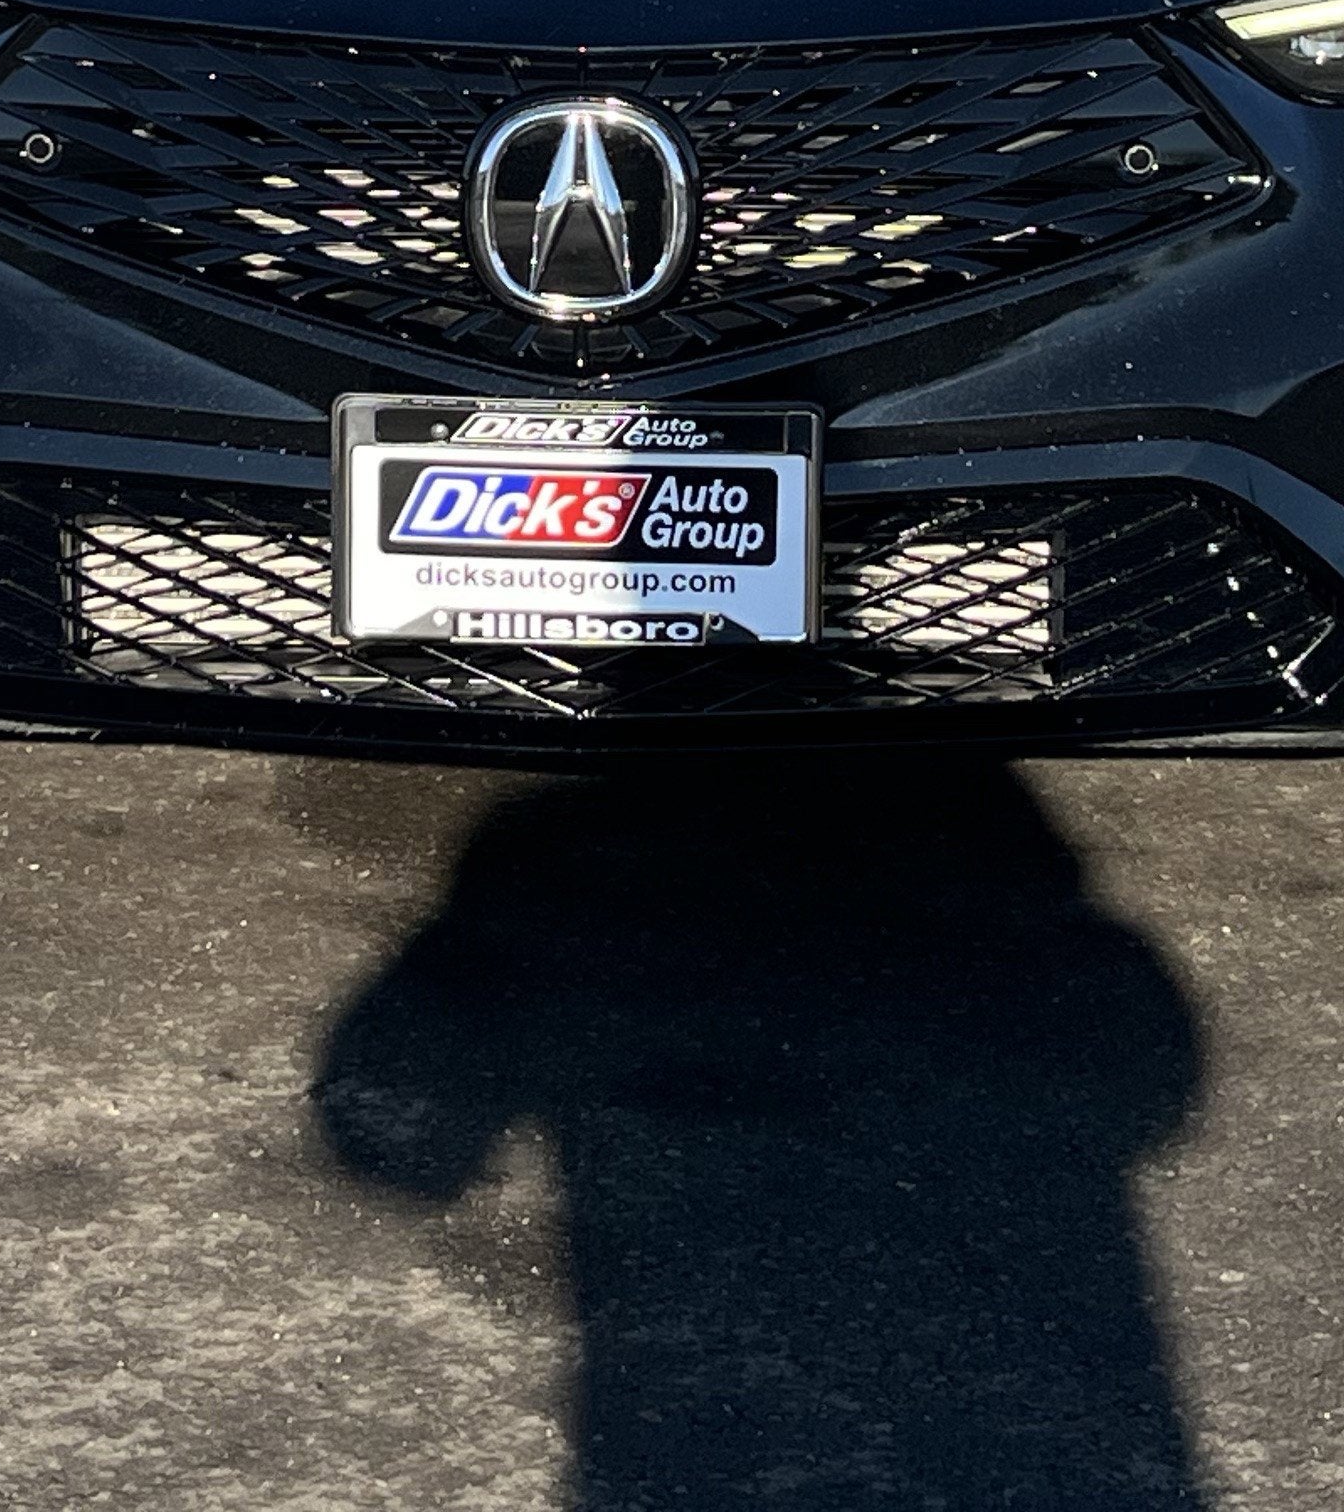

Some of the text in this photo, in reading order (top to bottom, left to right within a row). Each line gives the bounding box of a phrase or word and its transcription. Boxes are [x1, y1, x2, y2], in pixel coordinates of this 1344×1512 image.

[622, 430, 709, 450] Group
[632, 416, 698, 434] Auto
[409, 475, 750, 537] Dick's Auto
[641, 512, 766, 558] Group
[415, 562, 736, 598] dicksautogroup.com
[457, 610, 700, 641] Hillsboro
